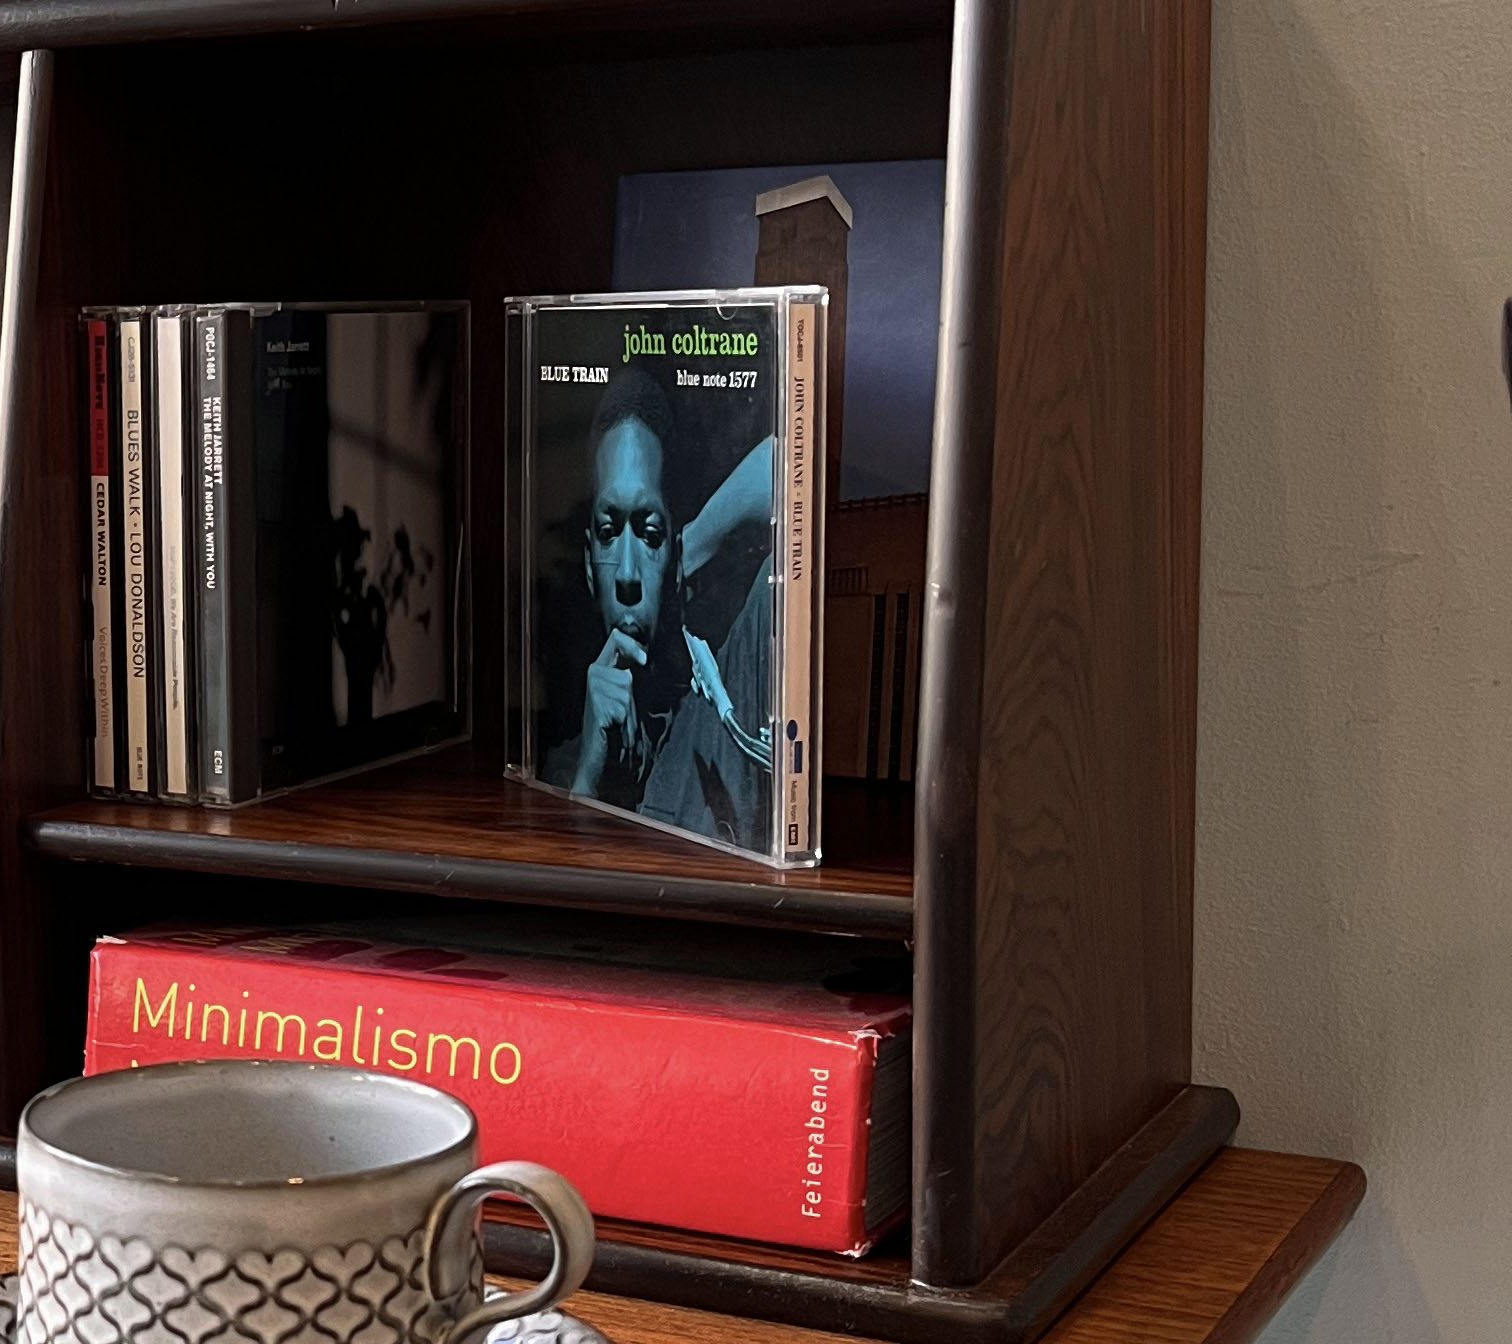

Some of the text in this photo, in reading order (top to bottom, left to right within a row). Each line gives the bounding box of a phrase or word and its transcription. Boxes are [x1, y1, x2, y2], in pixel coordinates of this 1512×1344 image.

[622, 324, 759, 362] john coltrane
[540, 365, 609, 383] BLUE TRAIN
[677, 369, 758, 388] blue note 1577
[202, 397, 212, 419] THE
[203, 422, 213, 471] MELODY
[212, 397, 223, 485] KEITH JARRETT
[204, 474, 214, 489] AT
[792, 376, 805, 581] JOHN COLTRANE BLUE TRAIN
[96, 482, 107, 586] CEDAR WALTON
[127, 410, 145, 678] BLUES WALK LOU DONALDSON
[205, 531, 215, 562] WITH
[206, 564, 216, 589] YOU
[214, 750, 223, 774] ECM
[131, 977, 522, 1086] Minimalismo
[801, 1068, 830, 1218] Feierabend
